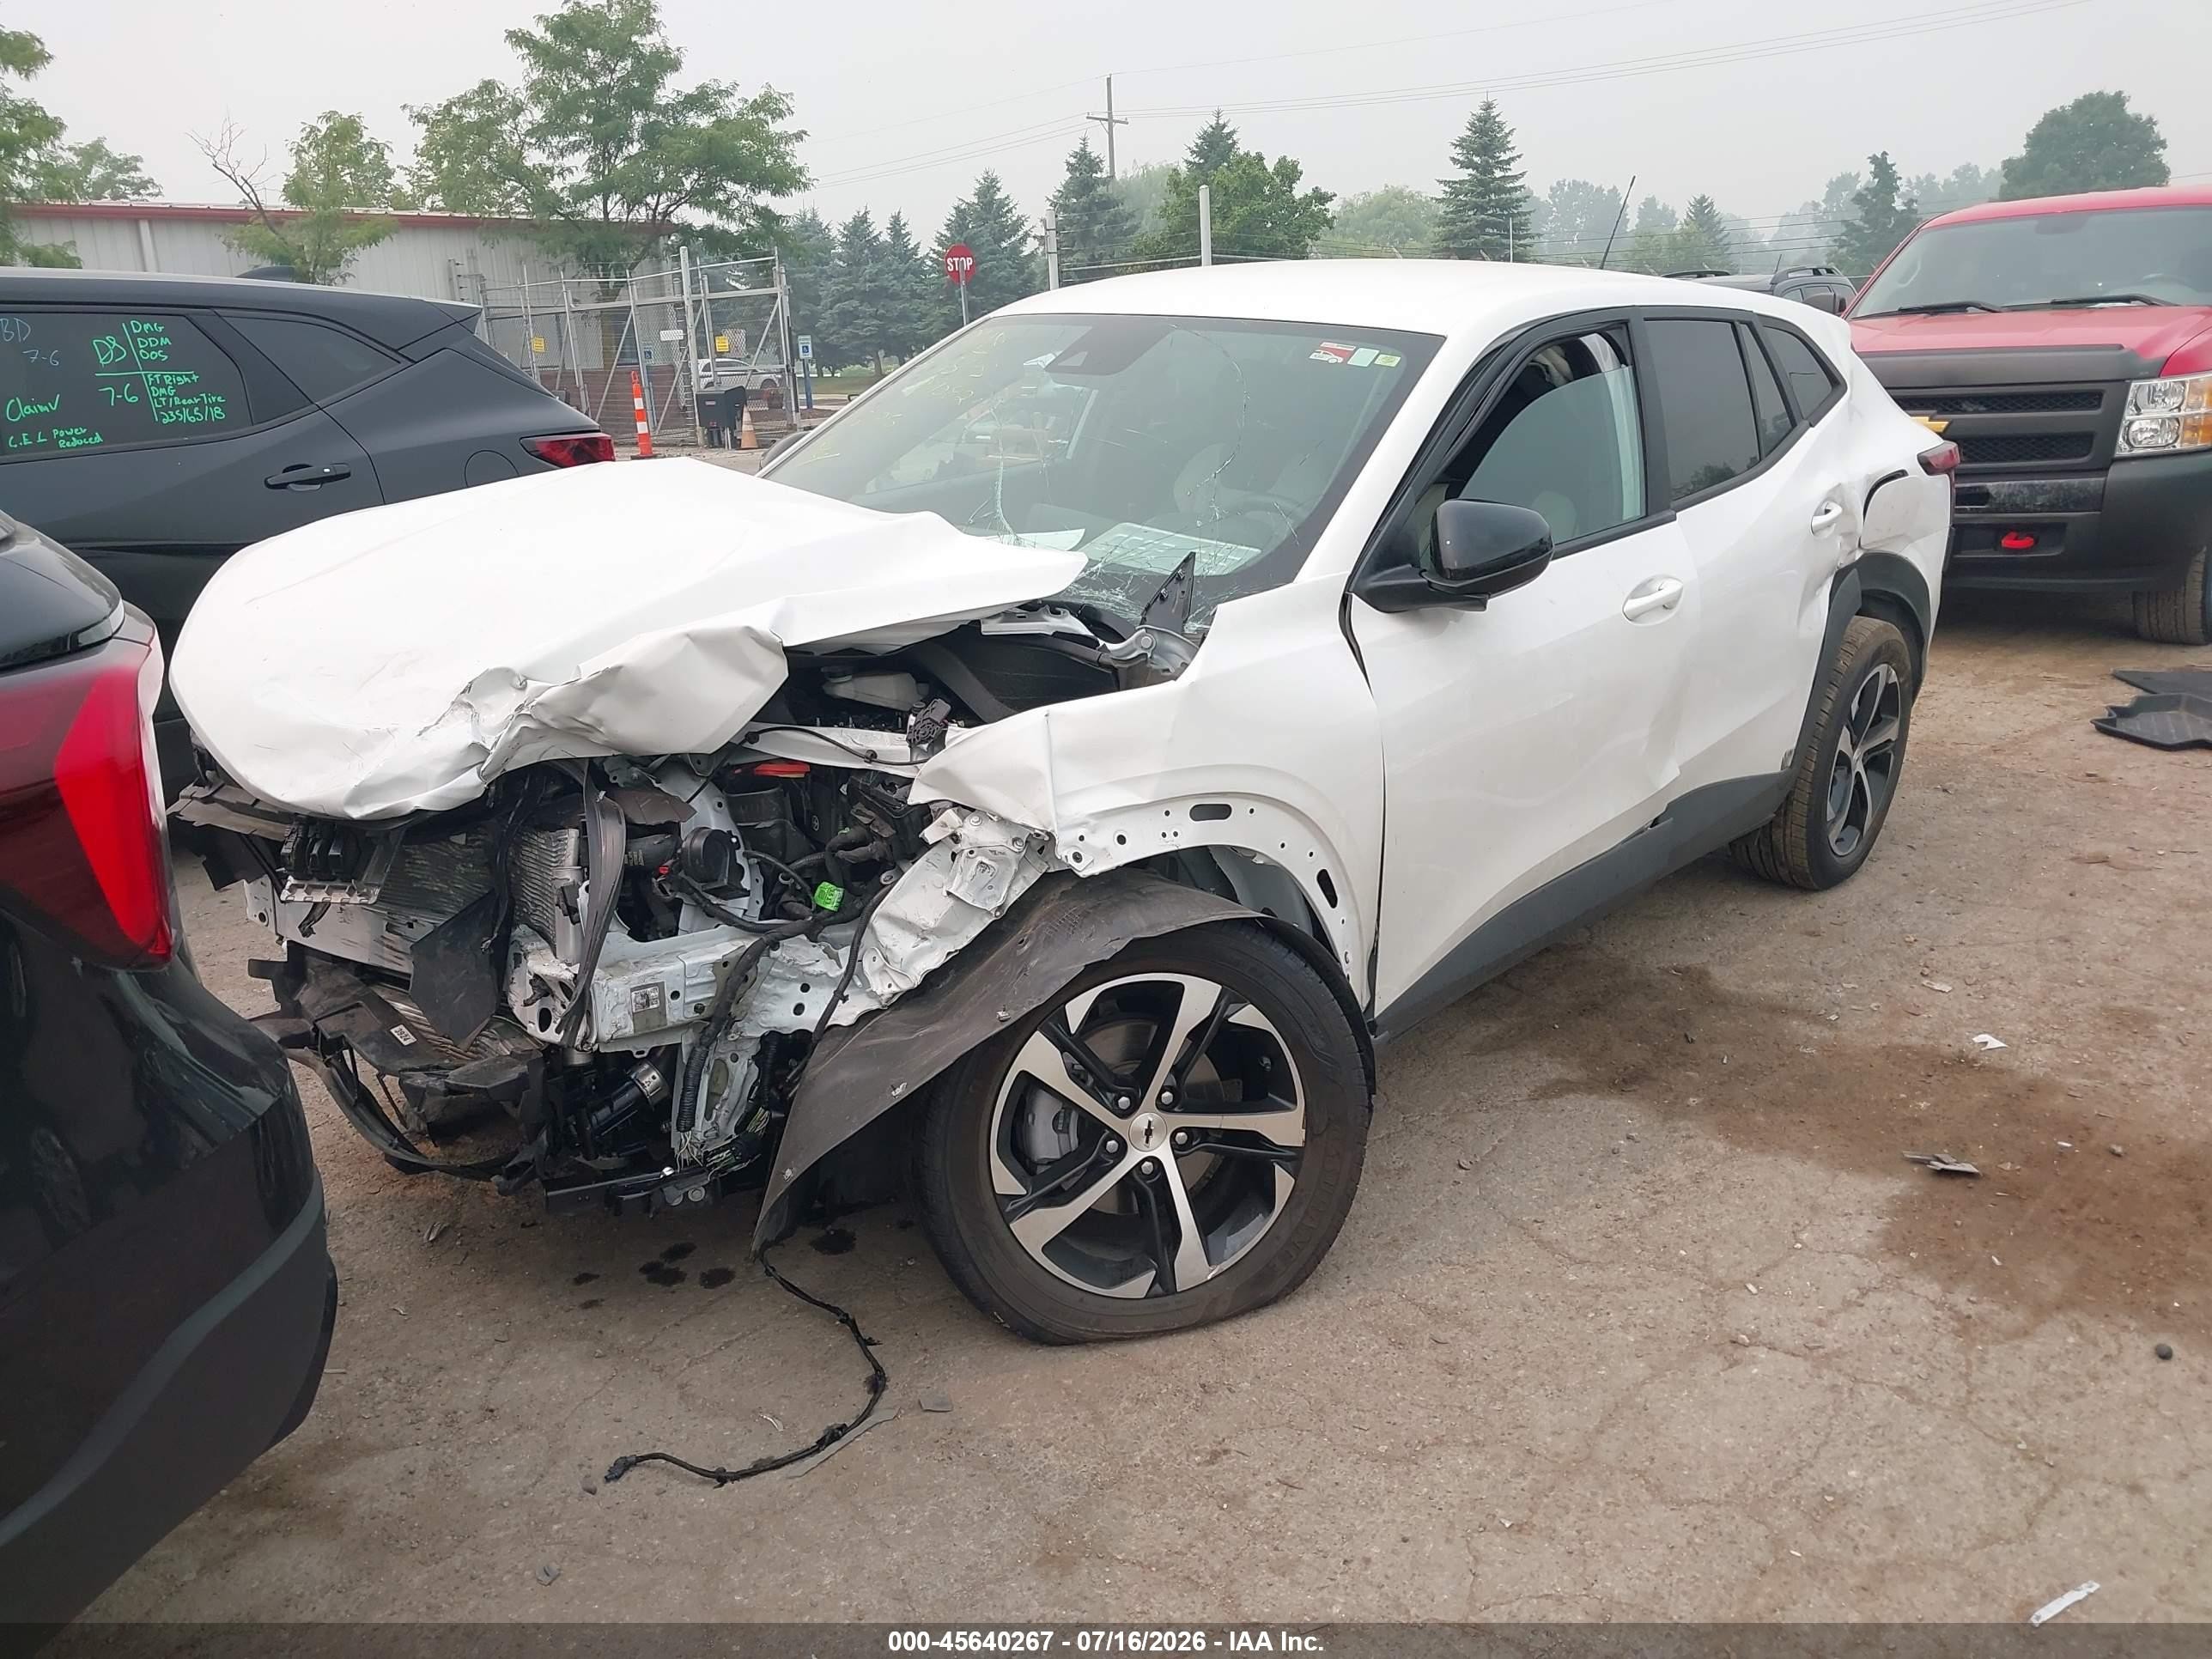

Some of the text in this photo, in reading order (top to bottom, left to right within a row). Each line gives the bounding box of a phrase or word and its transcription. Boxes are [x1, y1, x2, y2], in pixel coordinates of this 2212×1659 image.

[946, 257, 973, 271] STOP
[131, 319, 164, 334] DMG
[163, 374, 199, 386] Right
[98, 383, 139, 406] 7-6
[150, 386, 177, 398] DMG
[199, 392, 226, 404] Tire
